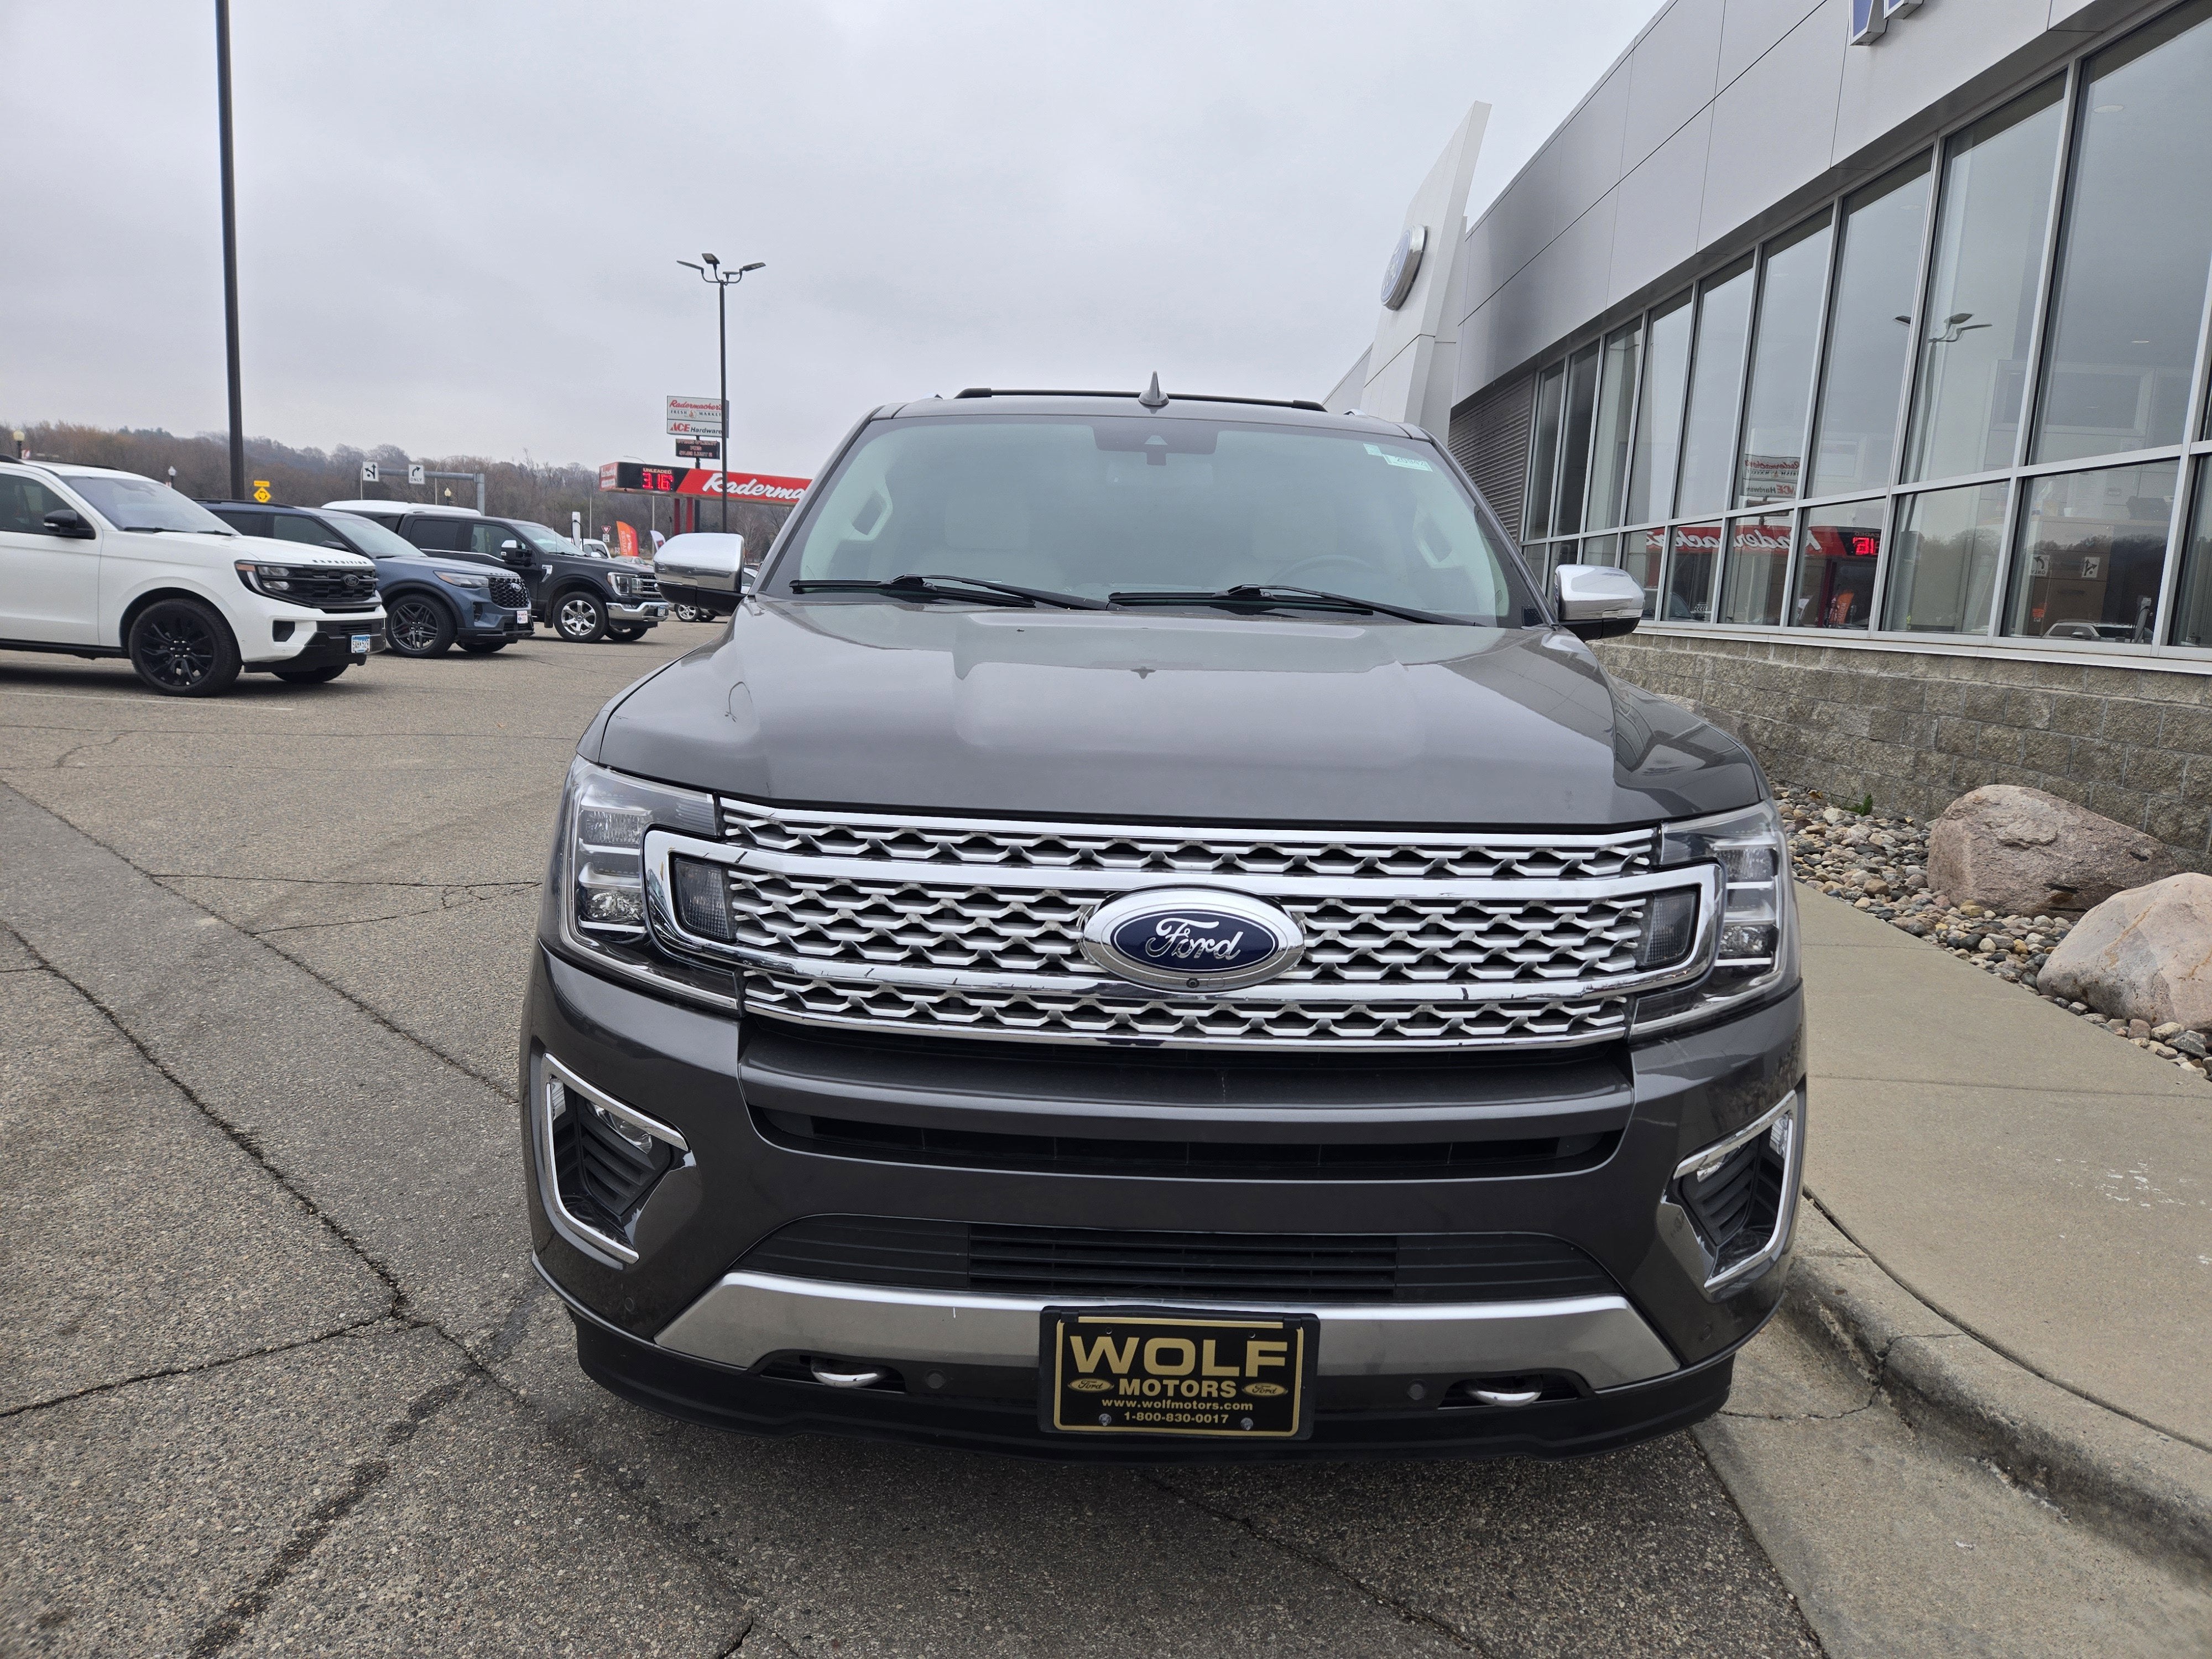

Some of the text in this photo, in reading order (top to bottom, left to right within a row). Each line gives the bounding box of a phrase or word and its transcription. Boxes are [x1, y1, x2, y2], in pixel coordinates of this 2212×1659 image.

[670, 422, 690, 432] ACE
[1145, 917, 1243, 960] Ford
[1070, 1336, 1288, 1377] WOLF
[1078, 1378, 1277, 1399] Ford MOTORS Ford
[1102, 1399, 1253, 1411] www.wolfmotors.com
[1124, 1411, 1229, 1423] 1-800-830-0017
